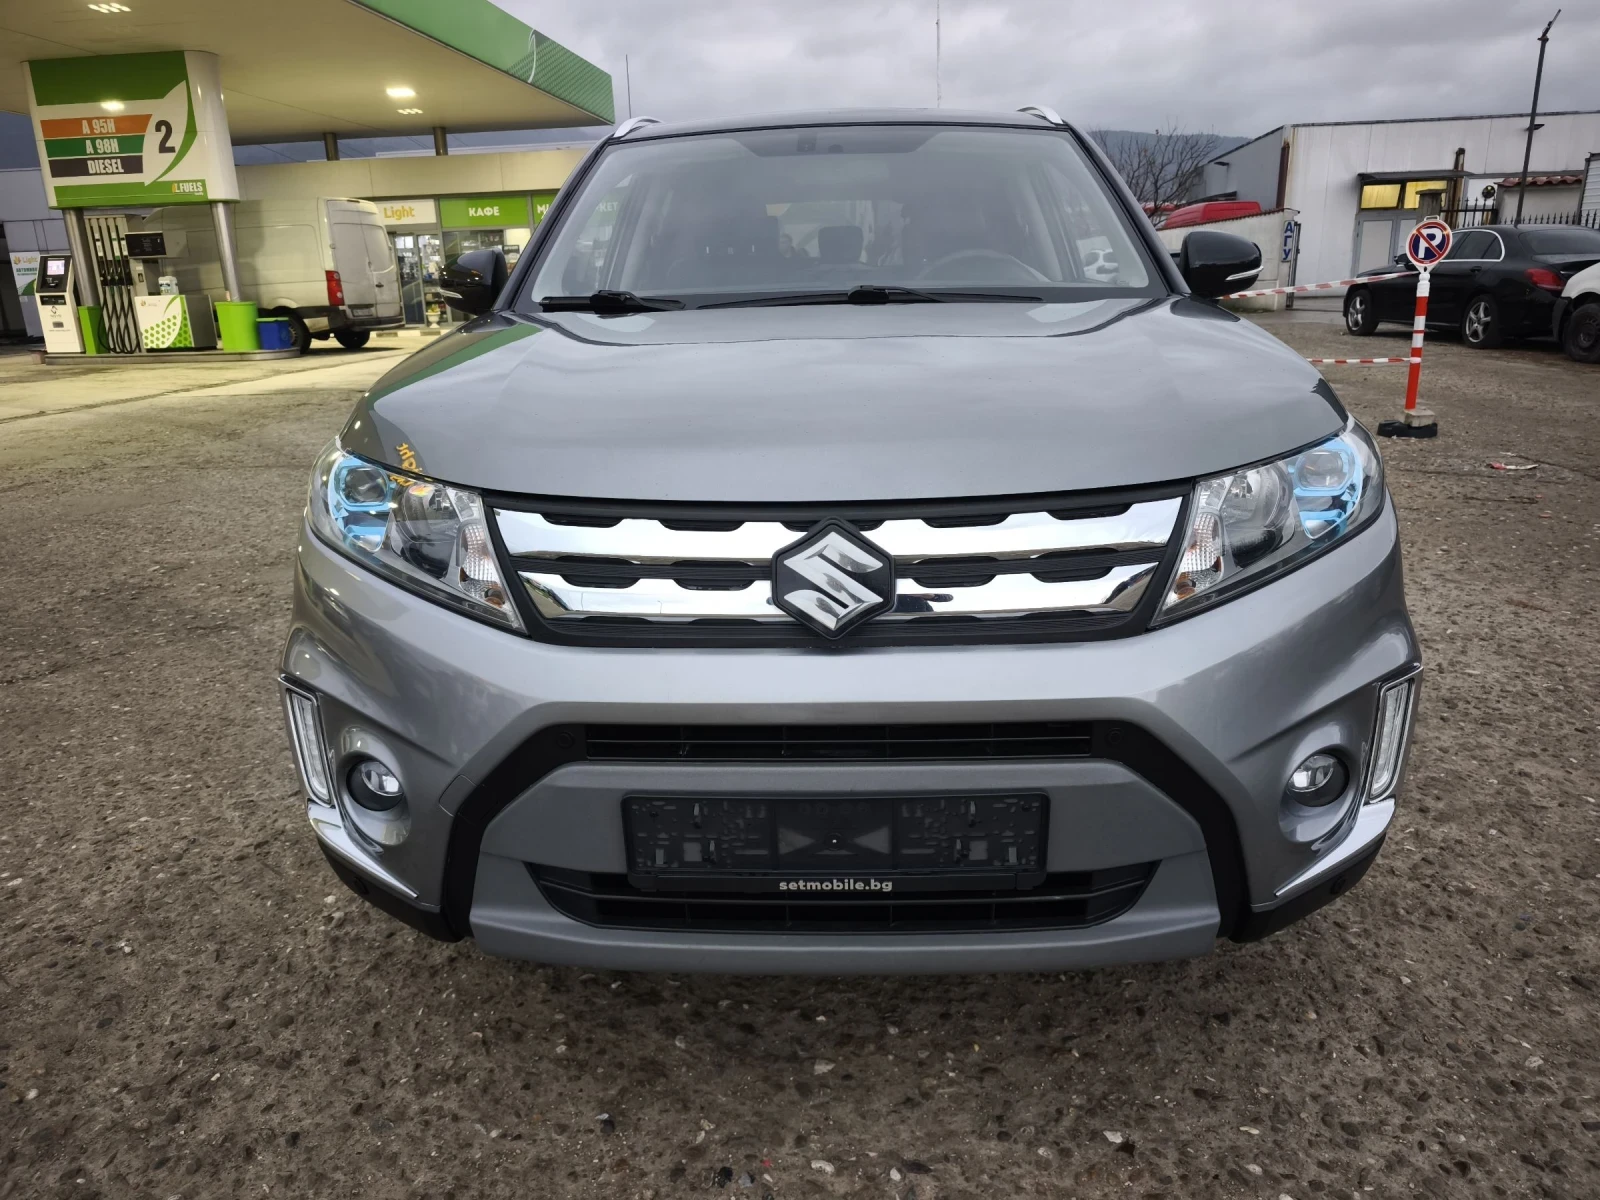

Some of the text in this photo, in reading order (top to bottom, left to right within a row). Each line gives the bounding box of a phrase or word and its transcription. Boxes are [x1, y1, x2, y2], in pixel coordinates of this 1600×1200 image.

[82, 119, 91, 134] A
[155, 119, 176, 154] 2
[85, 139, 95, 154] A
[87, 158, 125, 174] DIESEL
[383, 206, 416, 220] Light
[468, 206, 500, 217] КАФЕ
[779, 878, 893, 892] setmobile.bg
